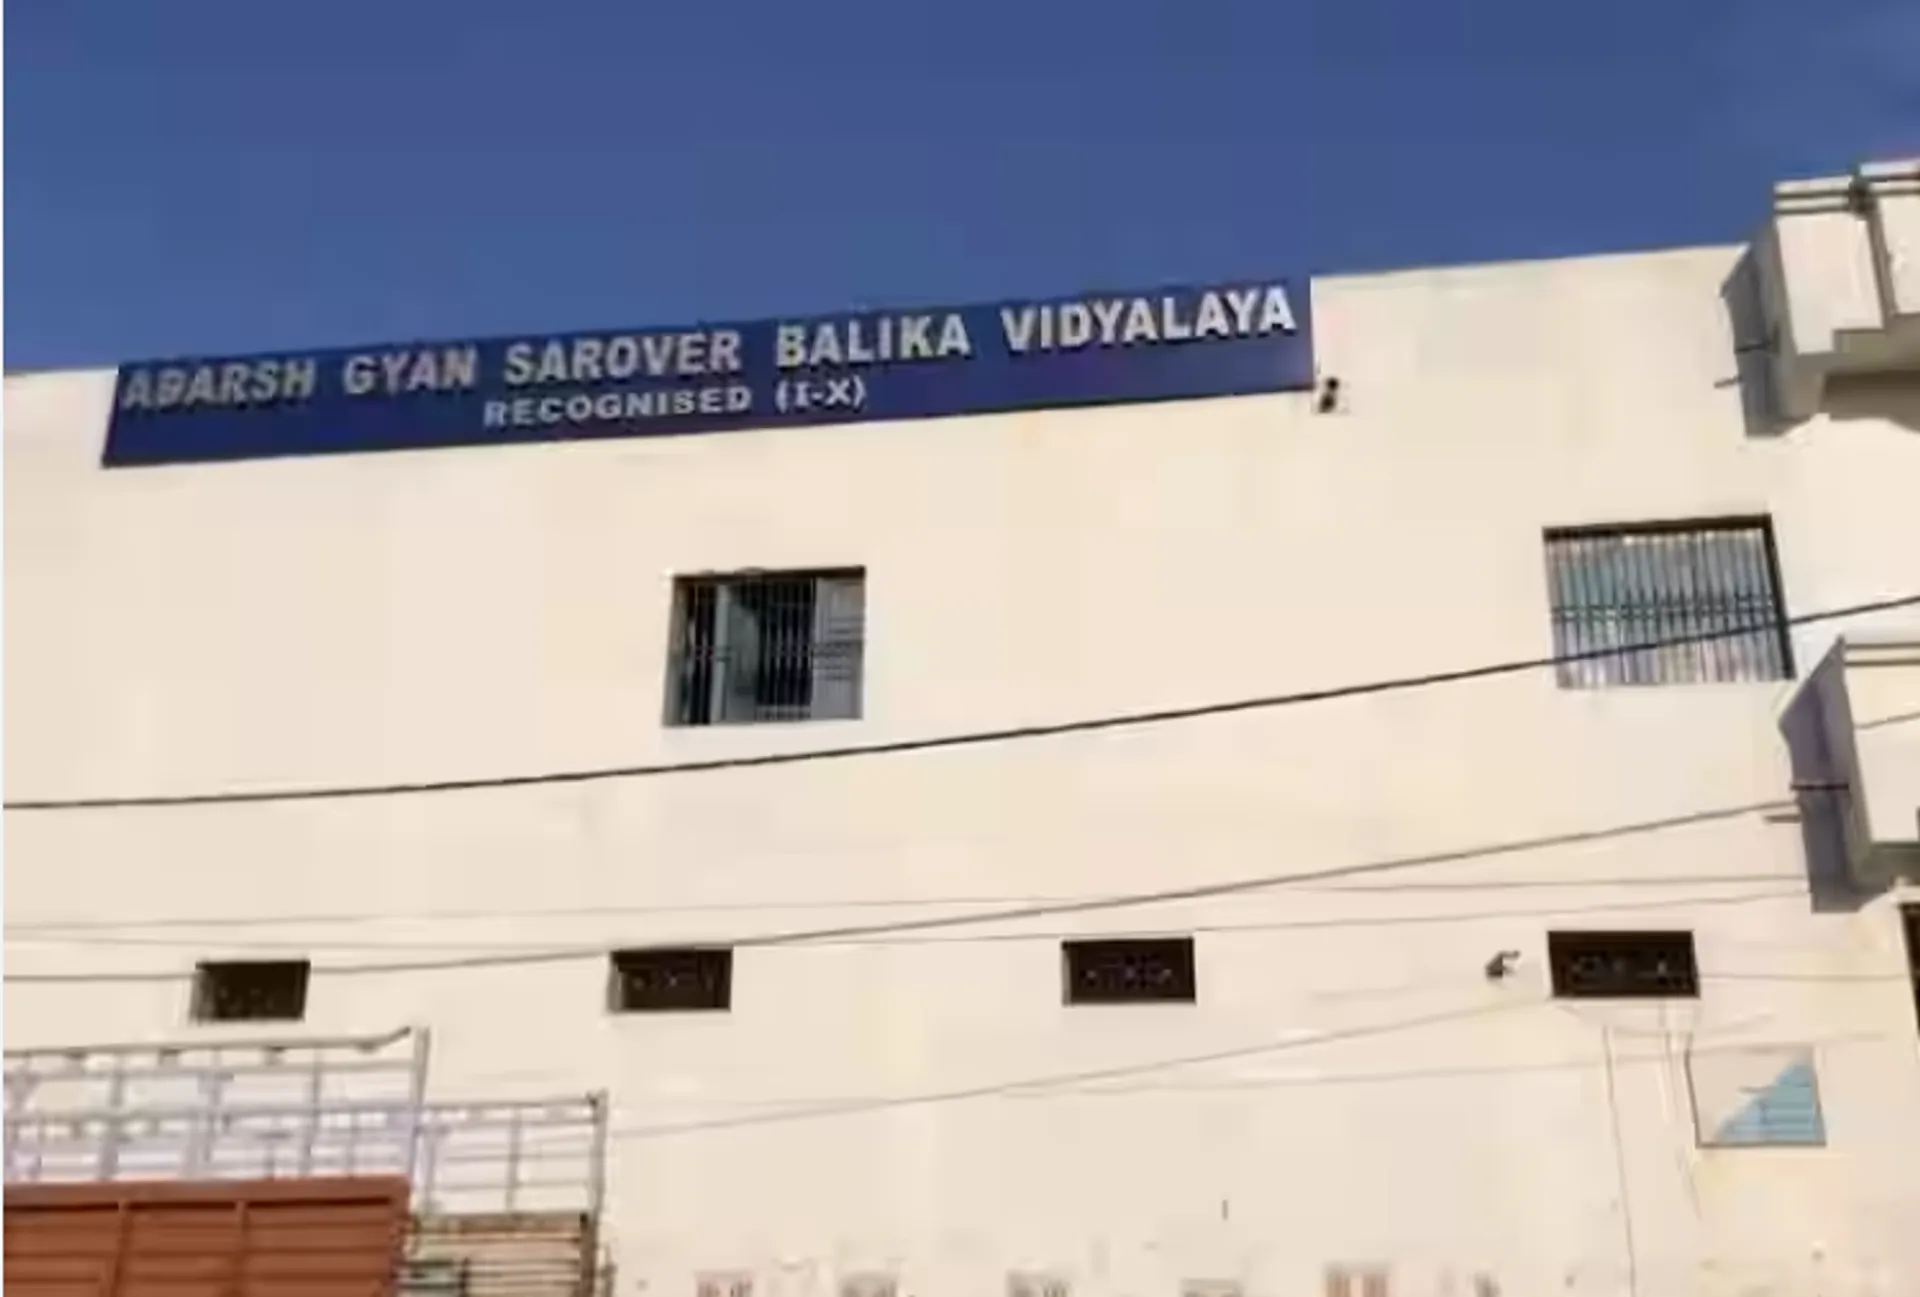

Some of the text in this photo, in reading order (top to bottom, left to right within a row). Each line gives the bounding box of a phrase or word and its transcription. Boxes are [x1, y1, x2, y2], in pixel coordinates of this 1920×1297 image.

[342, 346, 478, 397] GYAN
[503, 329, 742, 385] SAROVER
[775, 314, 971, 367] BALIKA
[1001, 286, 1297, 352] VIDYALAYA
[483, 375, 867, 427] RECOGNISED (I-X)
